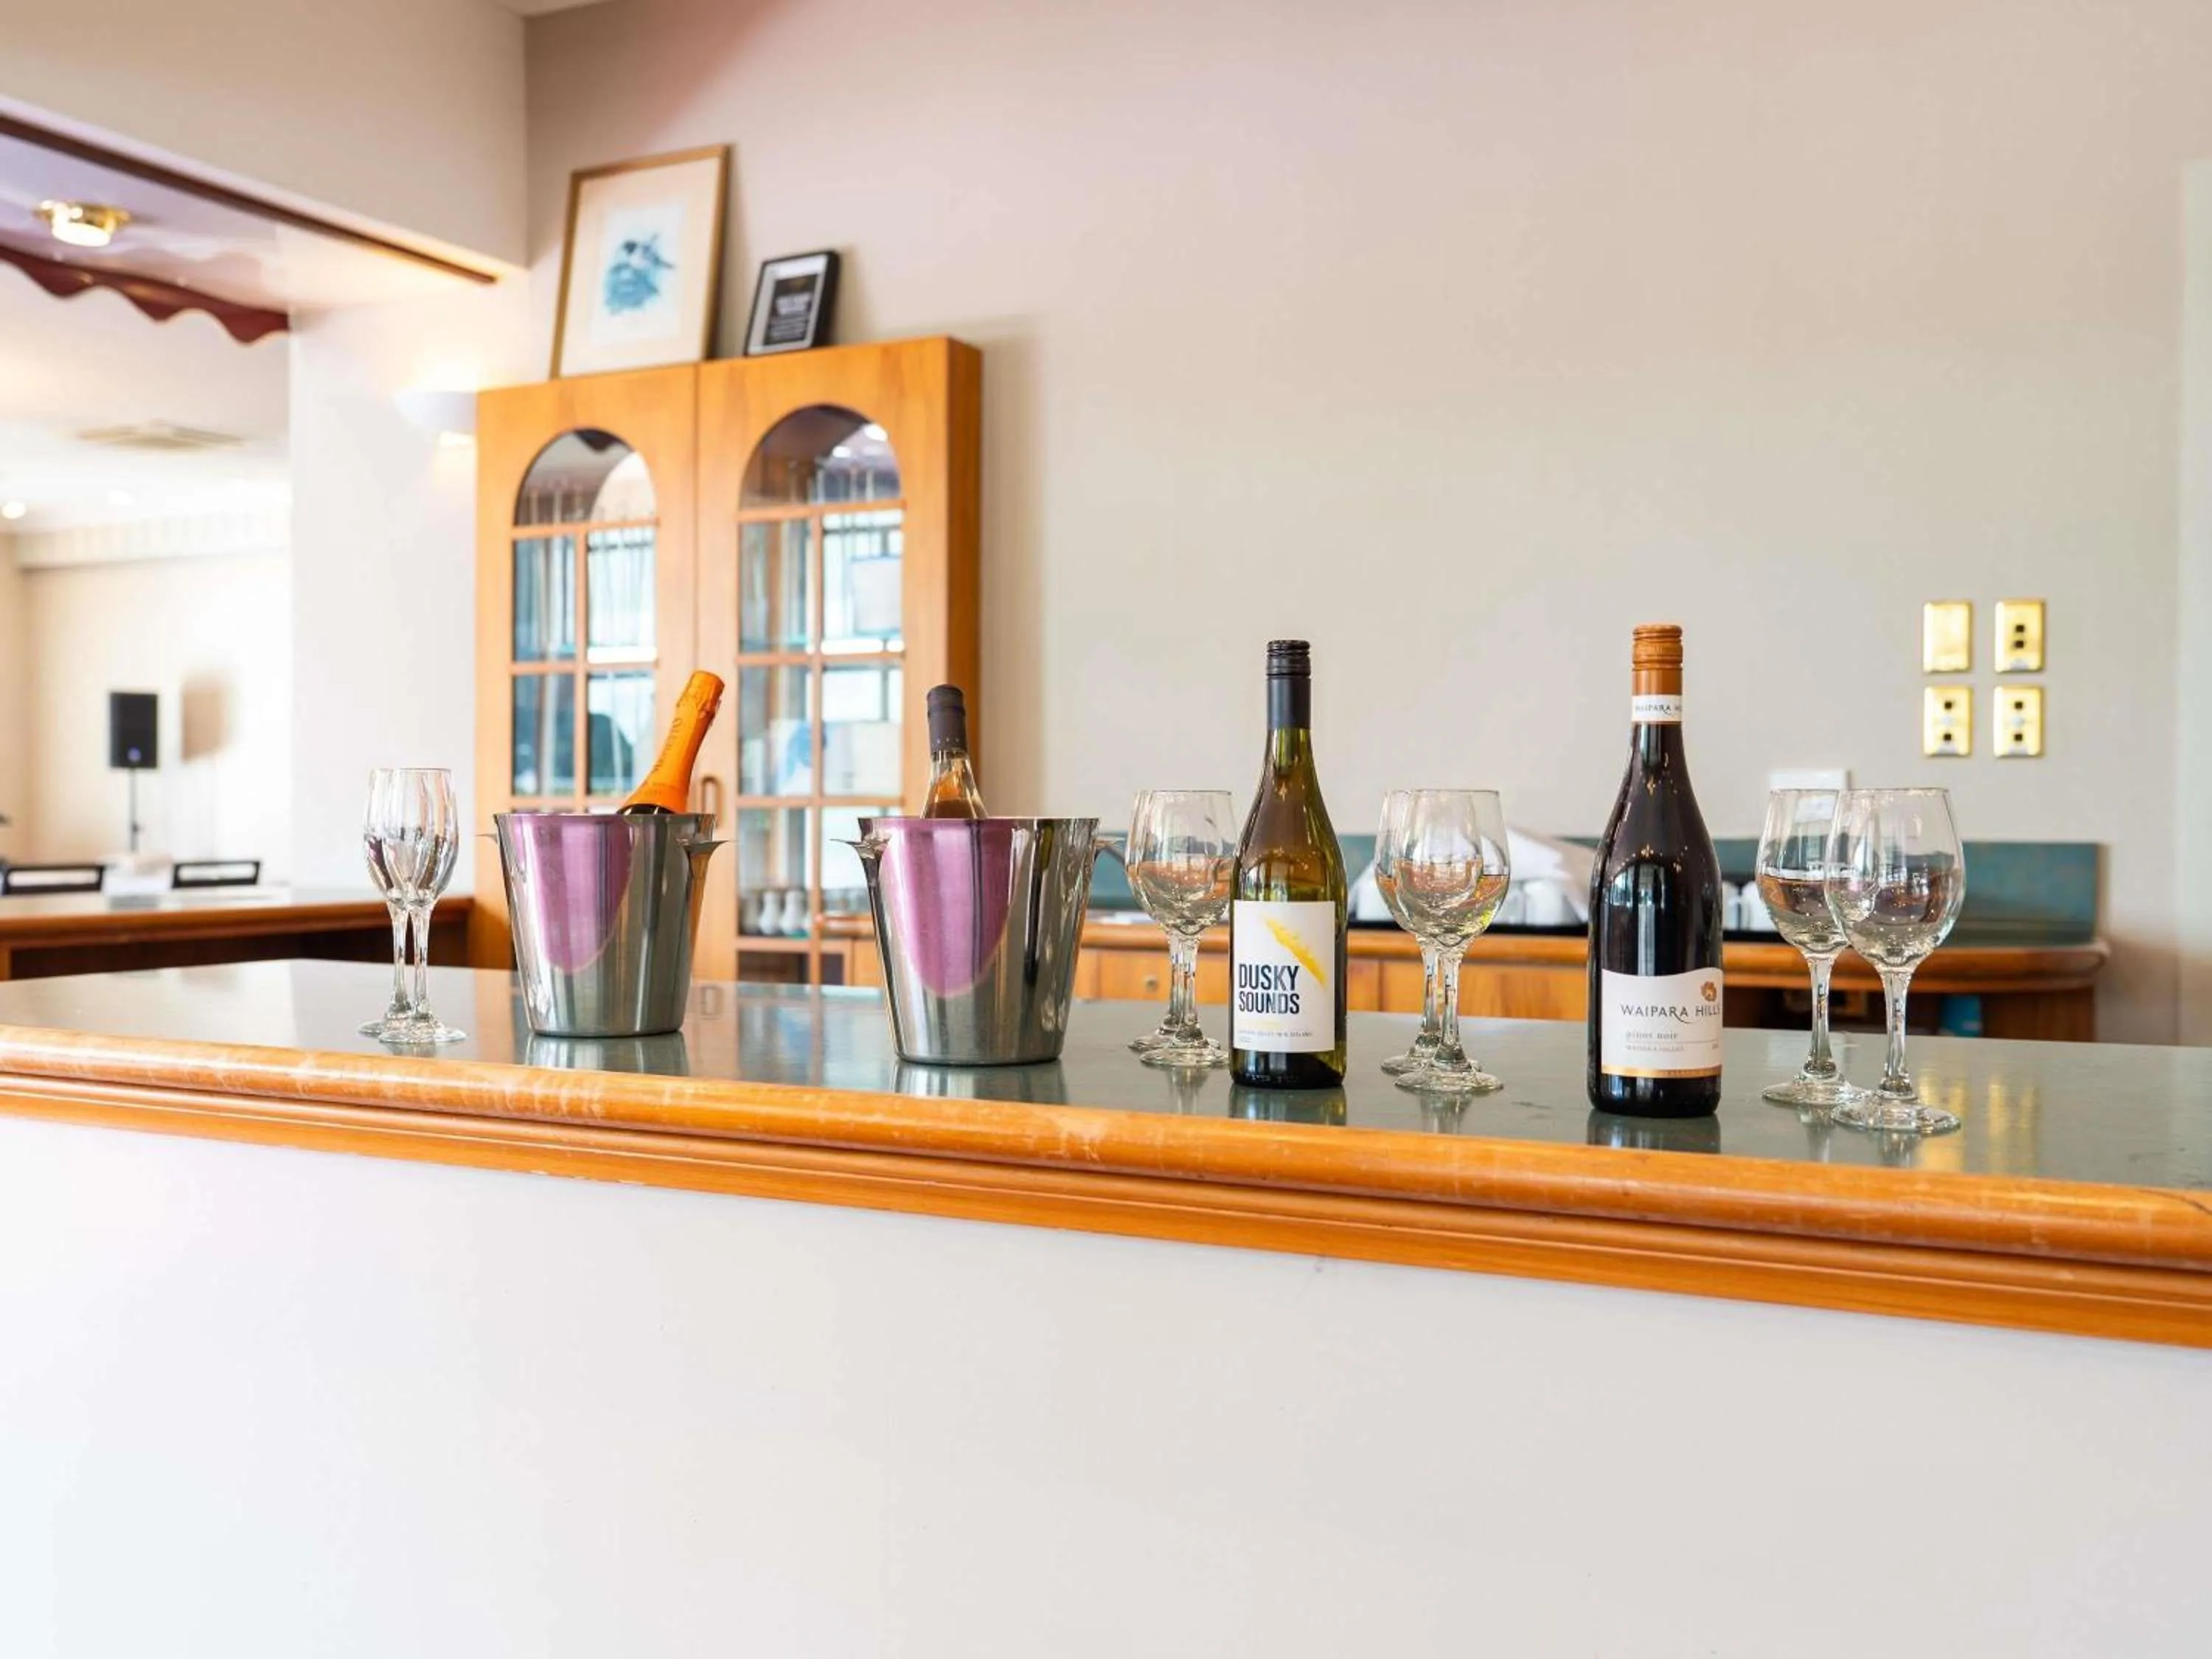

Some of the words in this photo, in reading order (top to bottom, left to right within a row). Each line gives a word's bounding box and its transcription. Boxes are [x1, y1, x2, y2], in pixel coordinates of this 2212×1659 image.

[1239, 963, 1299, 991] DUSKY
[1239, 991, 1299, 1015] SOUNDS
[1621, 1004, 1692, 1023] WAIPARA
